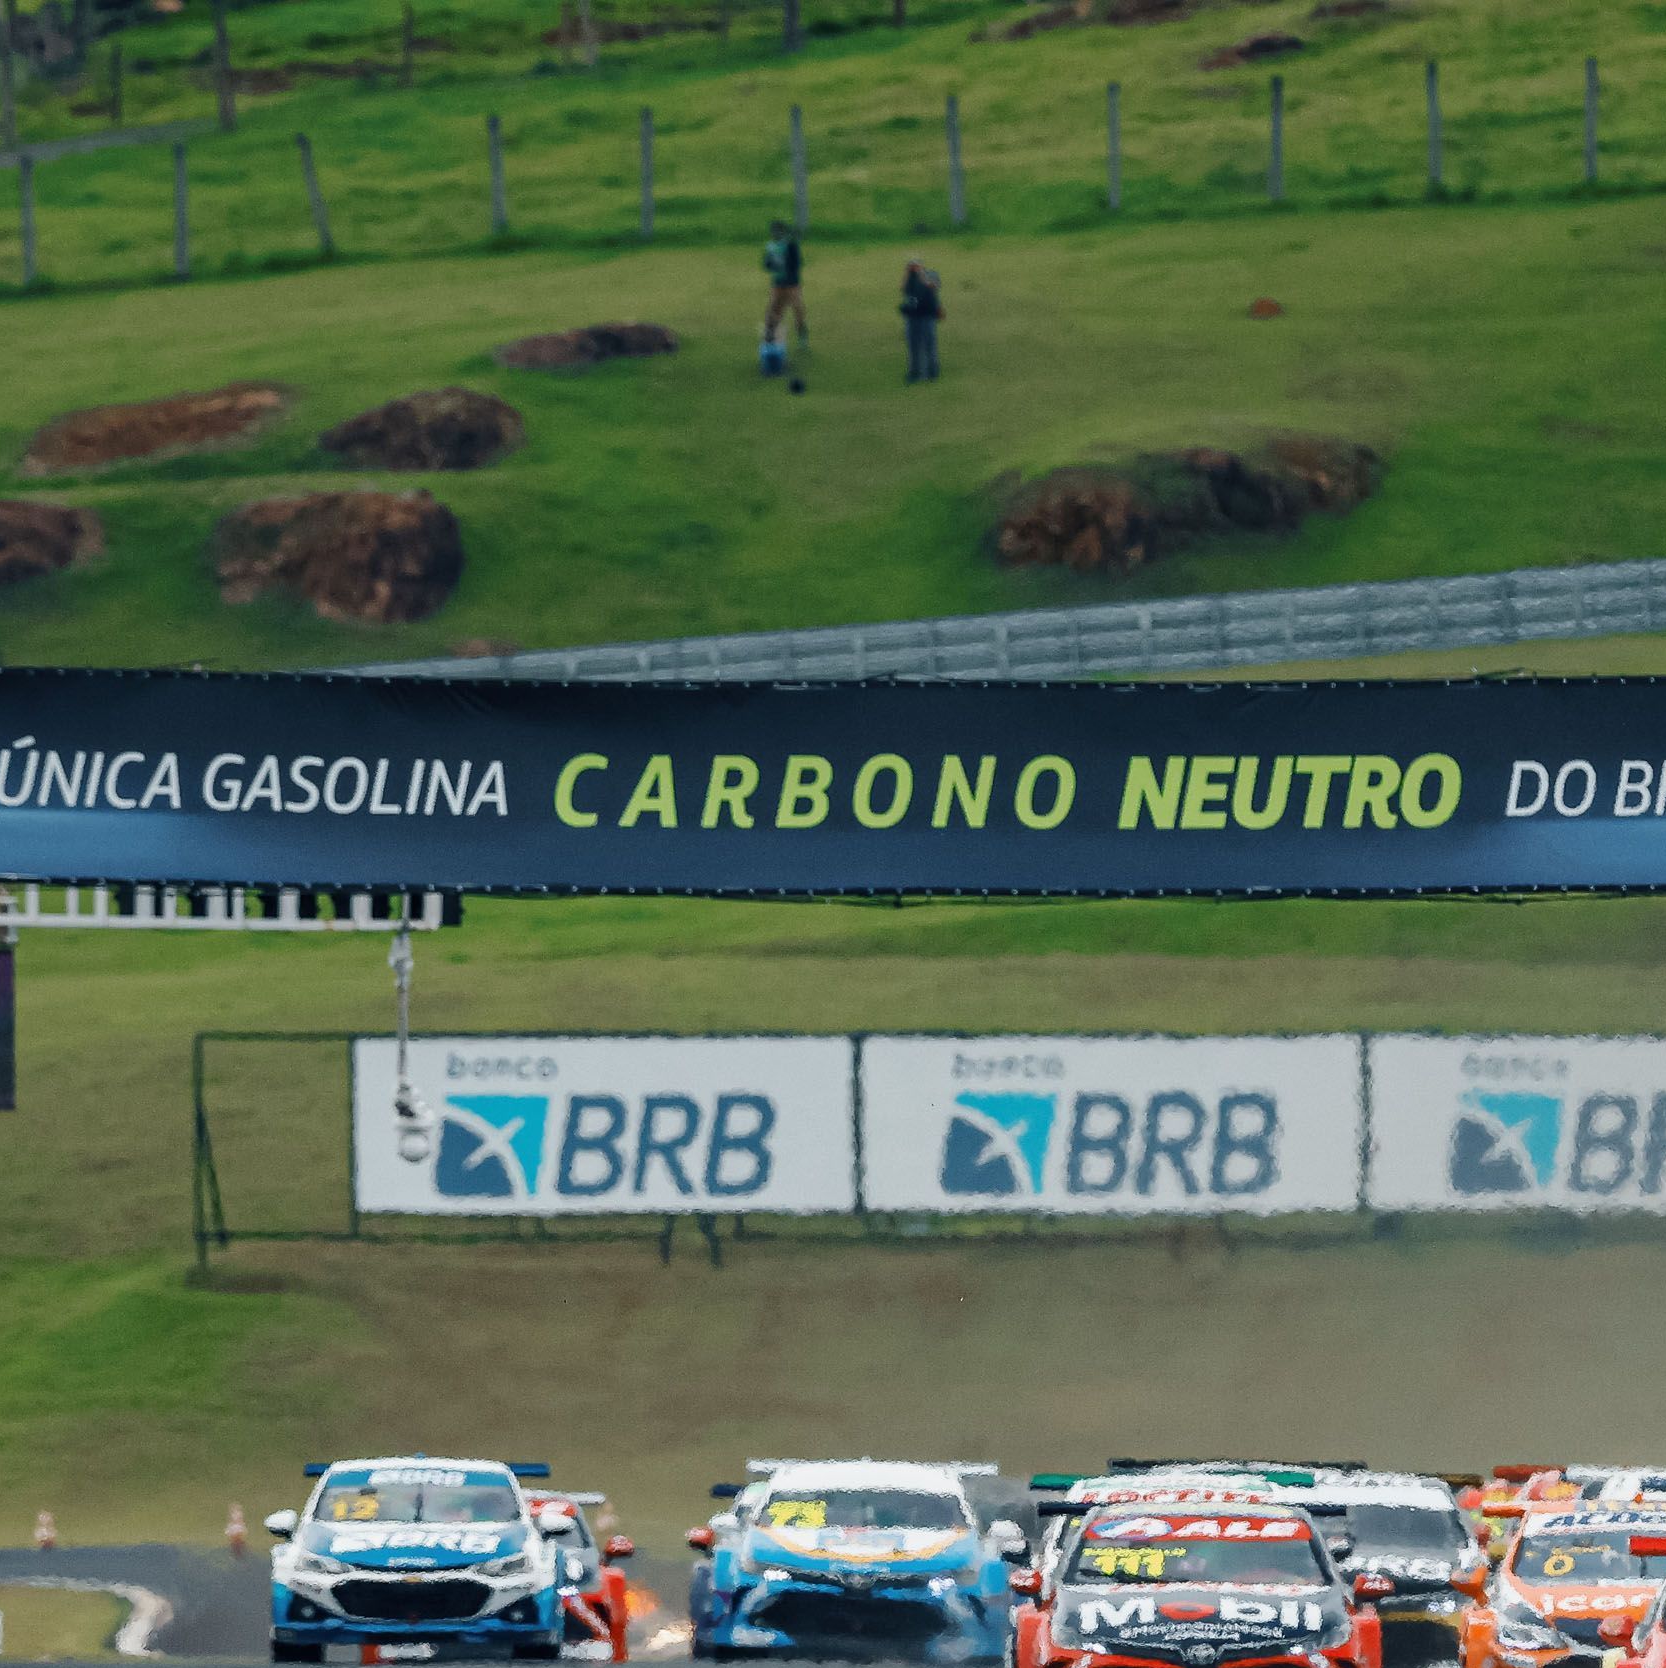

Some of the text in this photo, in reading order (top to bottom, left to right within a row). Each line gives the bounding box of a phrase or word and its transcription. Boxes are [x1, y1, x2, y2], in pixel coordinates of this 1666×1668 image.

[202, 752, 510, 817] GASOLINA
[552, 752, 1077, 831] CARBONO
[1118, 752, 1462, 832] NEUTRO
[1504, 758, 1597, 818] DO
[446, 1052, 557, 1079] banco
[555, 1092, 776, 1197] BRB
[1065, 1090, 1281, 1194] BRB
